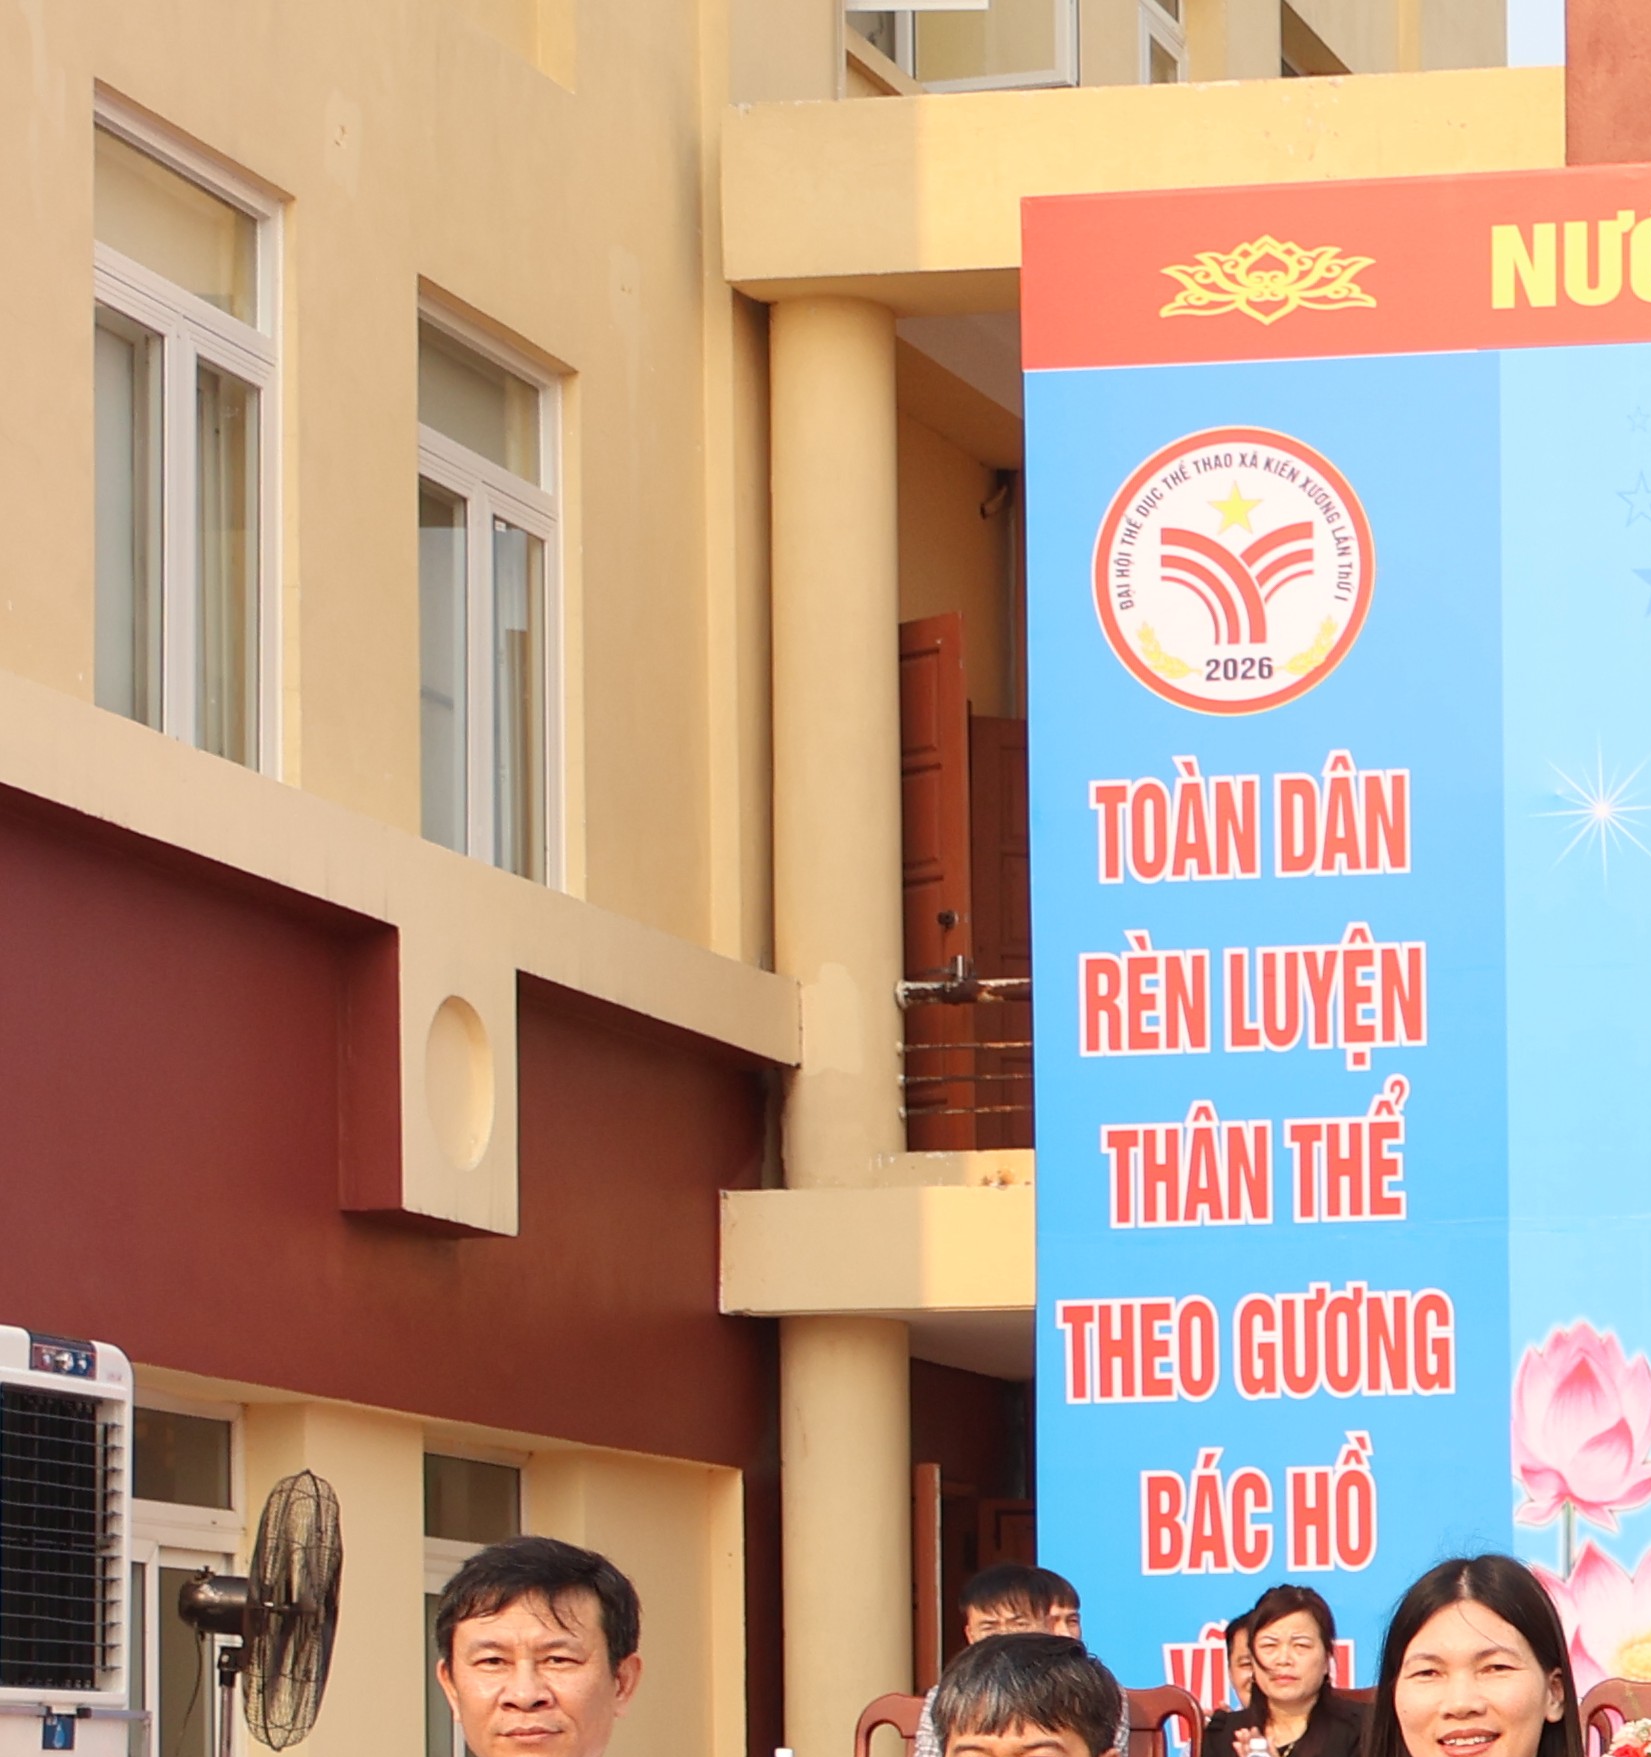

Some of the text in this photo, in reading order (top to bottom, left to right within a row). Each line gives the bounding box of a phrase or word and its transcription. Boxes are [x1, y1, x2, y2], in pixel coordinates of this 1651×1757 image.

[1193, 452, 1233, 475] THAO
[1239, 450, 1259, 468] XÃ
[1263, 457, 1300, 484] KIẾN
[1162, 459, 1192, 492] THỂ
[1136, 487, 1165, 518] DỤC
[1299, 475, 1342, 525] XƯƠNG
[1113, 552, 1133, 579] HỘI
[1117, 584, 1136, 611] ĐẠI
[1205, 656, 1274, 682] 2026
[1092, 752, 1409, 882] TOÀN DÂN
[1082, 925, 1425, 1068] RÈN LUYỆN
[1104, 1076, 1405, 1226] THÂN THỂ
[1059, 1284, 1454, 1401] THEO GƯƠNG
[1144, 1434, 1376, 1573] BÁC HỒ
